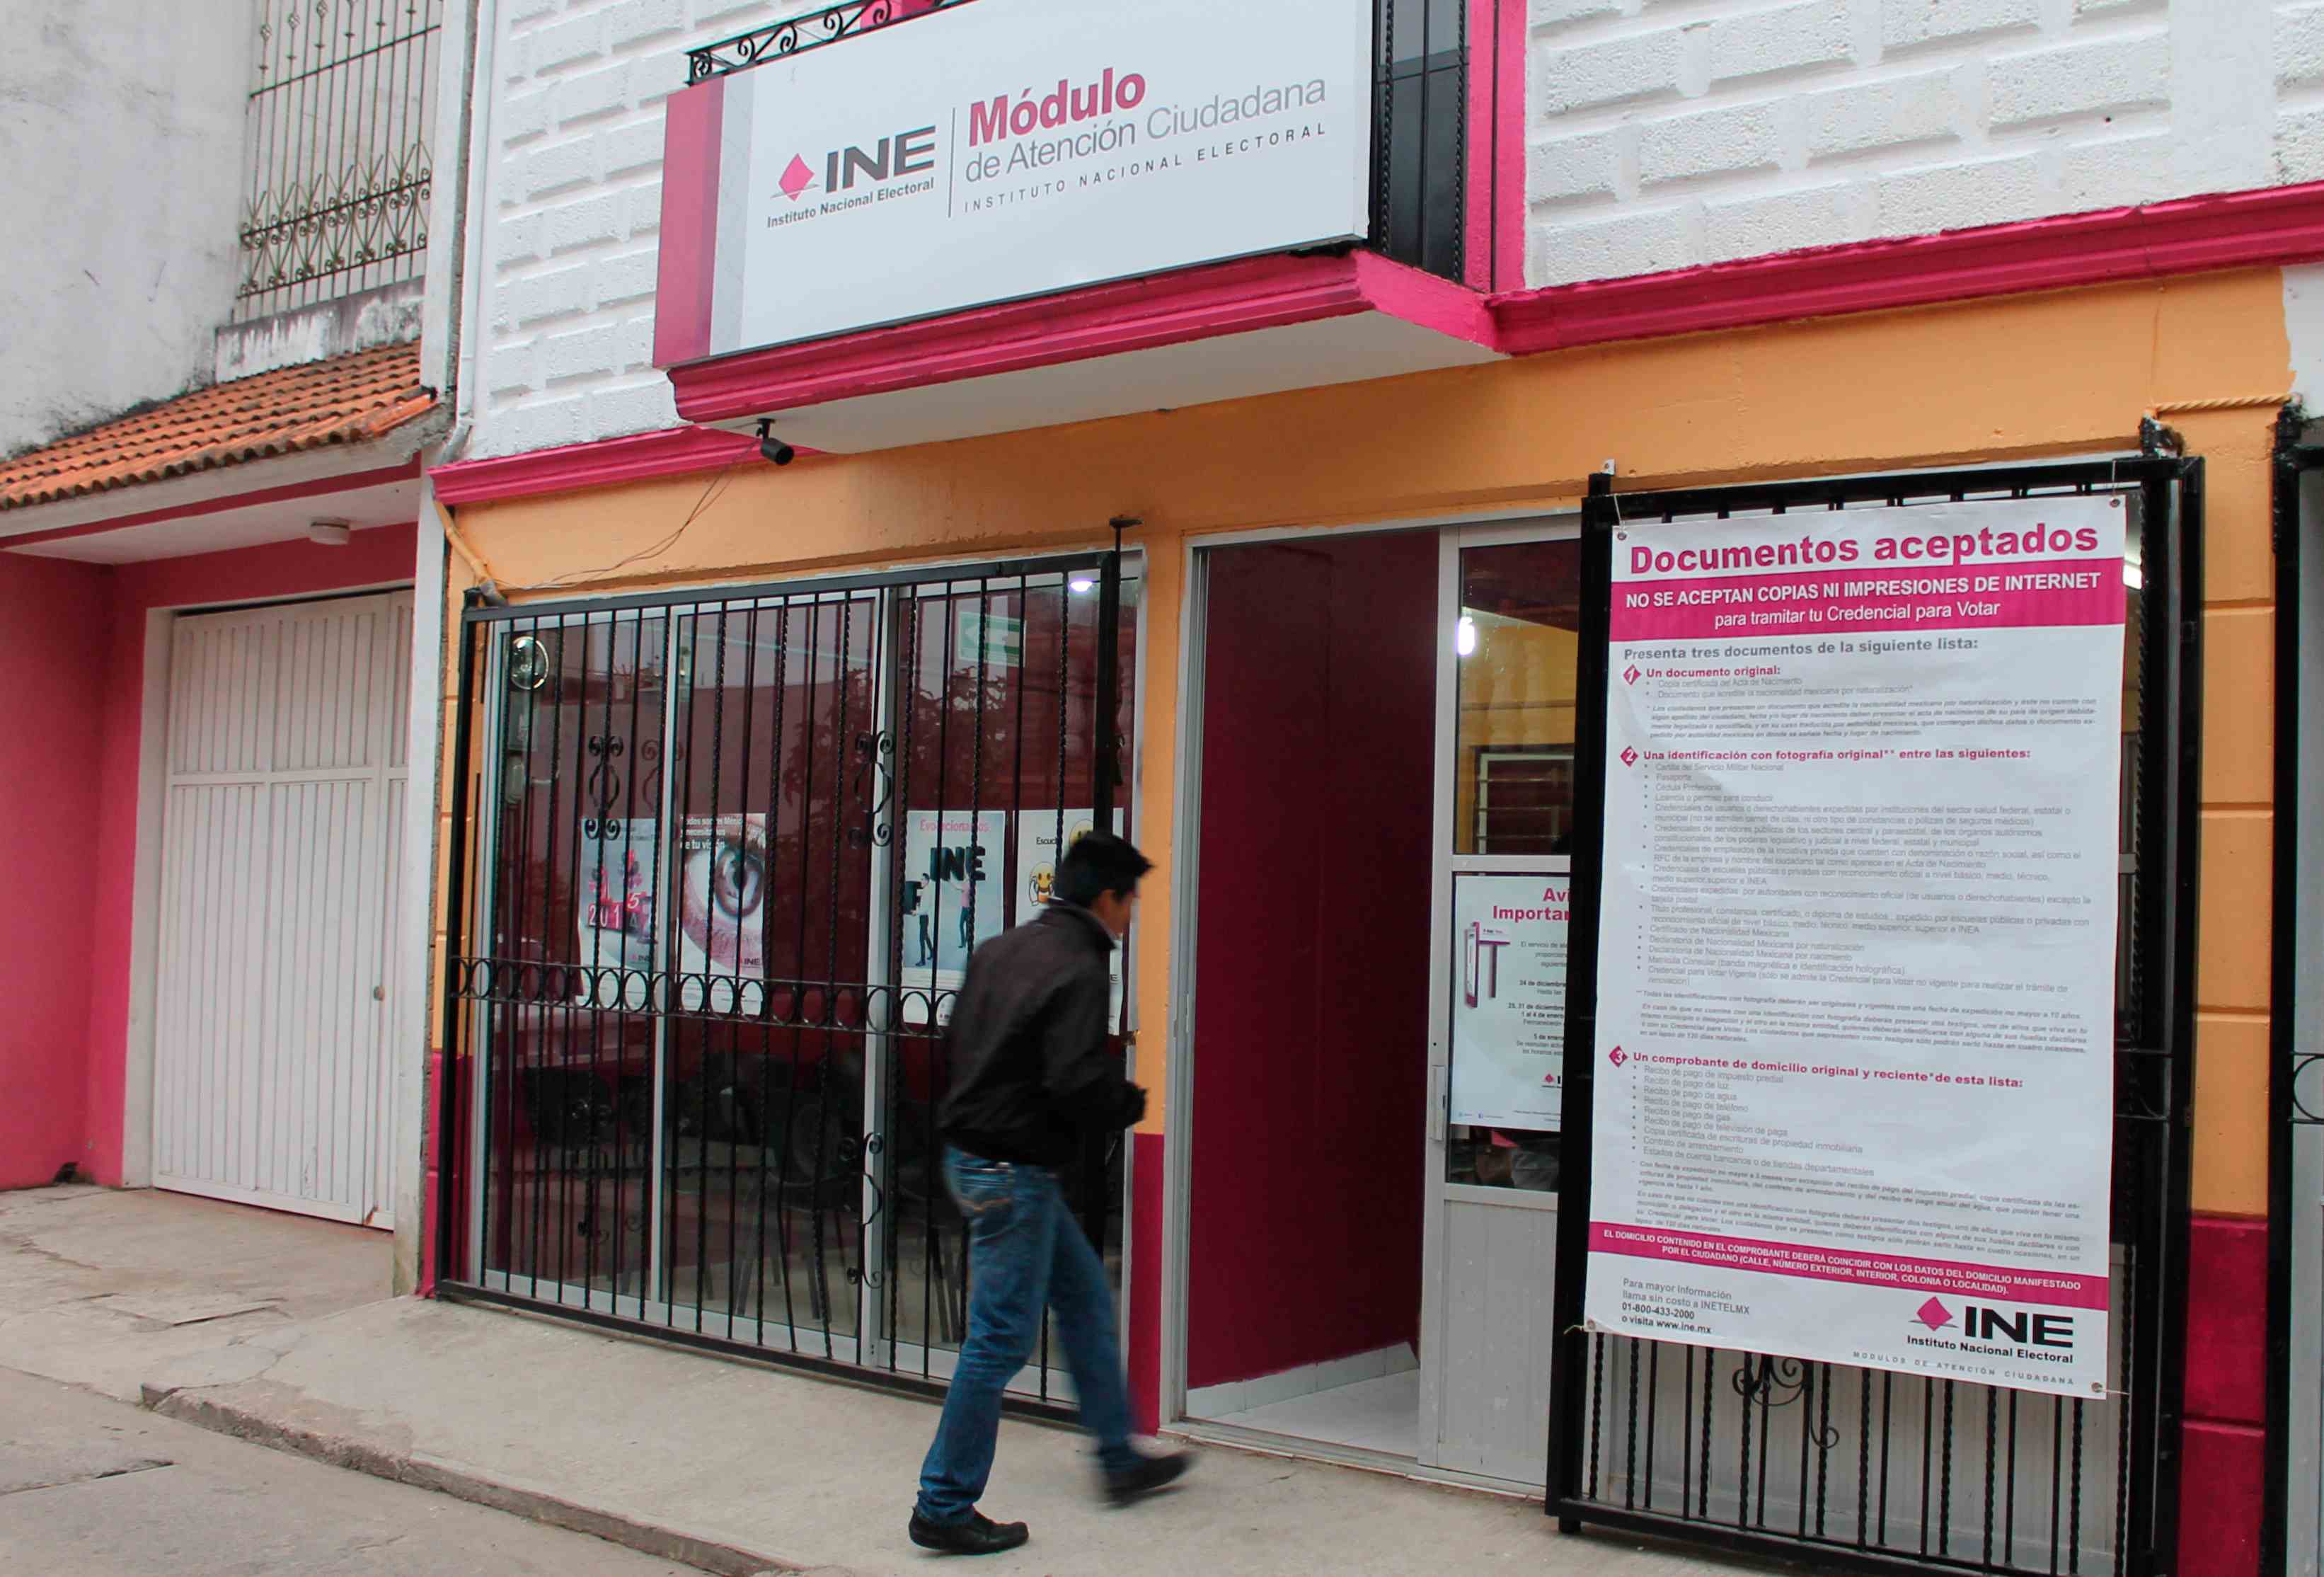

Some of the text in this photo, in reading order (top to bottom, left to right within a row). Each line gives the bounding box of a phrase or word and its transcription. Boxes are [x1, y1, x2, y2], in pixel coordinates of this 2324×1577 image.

[969, 67, 1146, 147] Módulo
[965, 79, 1325, 182] de Atención Ciudadana
[826, 125, 936, 193] INE
[965, 122, 1325, 212] INSTITUTO NACIONAL ELECTORAL
[767, 178, 934, 228] Instituto Nacional Electoral
[1631, 523, 2098, 573] Documentos aceptados
[1626, 572, 2100, 607] NO SE ACEPTAN COPIAS NI IMPRESIONES DE INTERNET
[1715, 602, 2000, 629] para tramitar tu Credencial para Votar
[1624, 638, 1977, 660] Presenta tres documentos de la siguiente lista:
[1647, 668, 1662, 677] Un
[1666, 667, 1730, 677] documento
[1734, 665, 1780, 677] original:
[1643, 750, 1664, 759] Una
[1668, 750, 1747, 759] identificación
[1776, 750, 1833, 760] fotografía
[1899, 750, 1931, 758] entre
[1935, 750, 1953, 758] las
[1959, 750, 2030, 760] siguientes:
[930, 846, 986, 881] INE
[1633, 1052, 1647, 1061] Un
[1652, 1055, 1728, 1067] comprobante
[1732, 1059, 1747, 1069] de
[1751, 1060, 1807, 1072] domicilio
[1812, 1065, 1858, 1076] original
[1935, 1073, 1950, 1082] de
[1955, 1076, 1984, 1084] esta
[1989, 1076, 2022, 1087] lista:
[1644, 1065, 1783, 1083] Recibo de pago de impuesto predial
[1643, 1096, 1748, 1112] Recibo de pago de teléfono
[1644, 1086, 1670, 1097] Recibo
[1670, 1087, 1681, 1098] de
[1681, 1088, 1703, 1099] pago
[1704, 1091, 1715, 1099] de
[1615, 1231, 1655, 1242] DOMICILIO
[1657, 1235, 1702, 1248] CONTENIDO
[1703, 1241, 1714, 1249] EN
[1715, 1242, 1725, 1251] EL
[1727, 1244, 1790, 1258] COMPROBANTE
[1792, 1251, 1826, 1263] DEBERÁ
[1827, 1256, 1871, 1268] COINCIDIR
[1873, 1261, 1892, 1270] CON
[1894, 1263, 1912, 1272] LOS
[1914, 1265, 1943, 1275] DATOS
[1946, 1268, 1963, 1278] DEL
[1966, 1271, 2011, 1283] DOMICILIO
[2013, 1276, 2081, 1290] MANIFESTADO
[1662, 1246, 1679, 1254] POR
[1691, 1249, 1738, 1262] CIUDADANO
[1739, 1256, 1771, 1267] (CALLE,
[1772, 1258, 1808, 1271] NÚMERO
[1810, 1263, 1854, 1276] EXTERIOR,
[1856, 1269, 1899, 1282] INTERIOR,
[1901, 1273, 1941, 1285] COLONIA
[1952, 1280, 2008, 1295] LOCALIDAD).
[1623, 1278, 1731, 1300] Para mayor información
[1623, 1290, 1749, 1315] llama sin costo a INETELMX
[1622, 1302, 1694, 1319] 01-800-433-2000
[1629, 1316, 1653, 1326] visita
[1656, 1319, 1711, 1334] www.ine.mx
[1965, 1306, 2074, 1348] INE
[1907, 1335, 2072, 1363] Instituto Nacional Electoral
[1914, 1358, 1928, 1367] DE
[1937, 1360, 1995, 1375] ATENCIÓN
[2004, 1370, 2073, 1384] CIUDADANA
